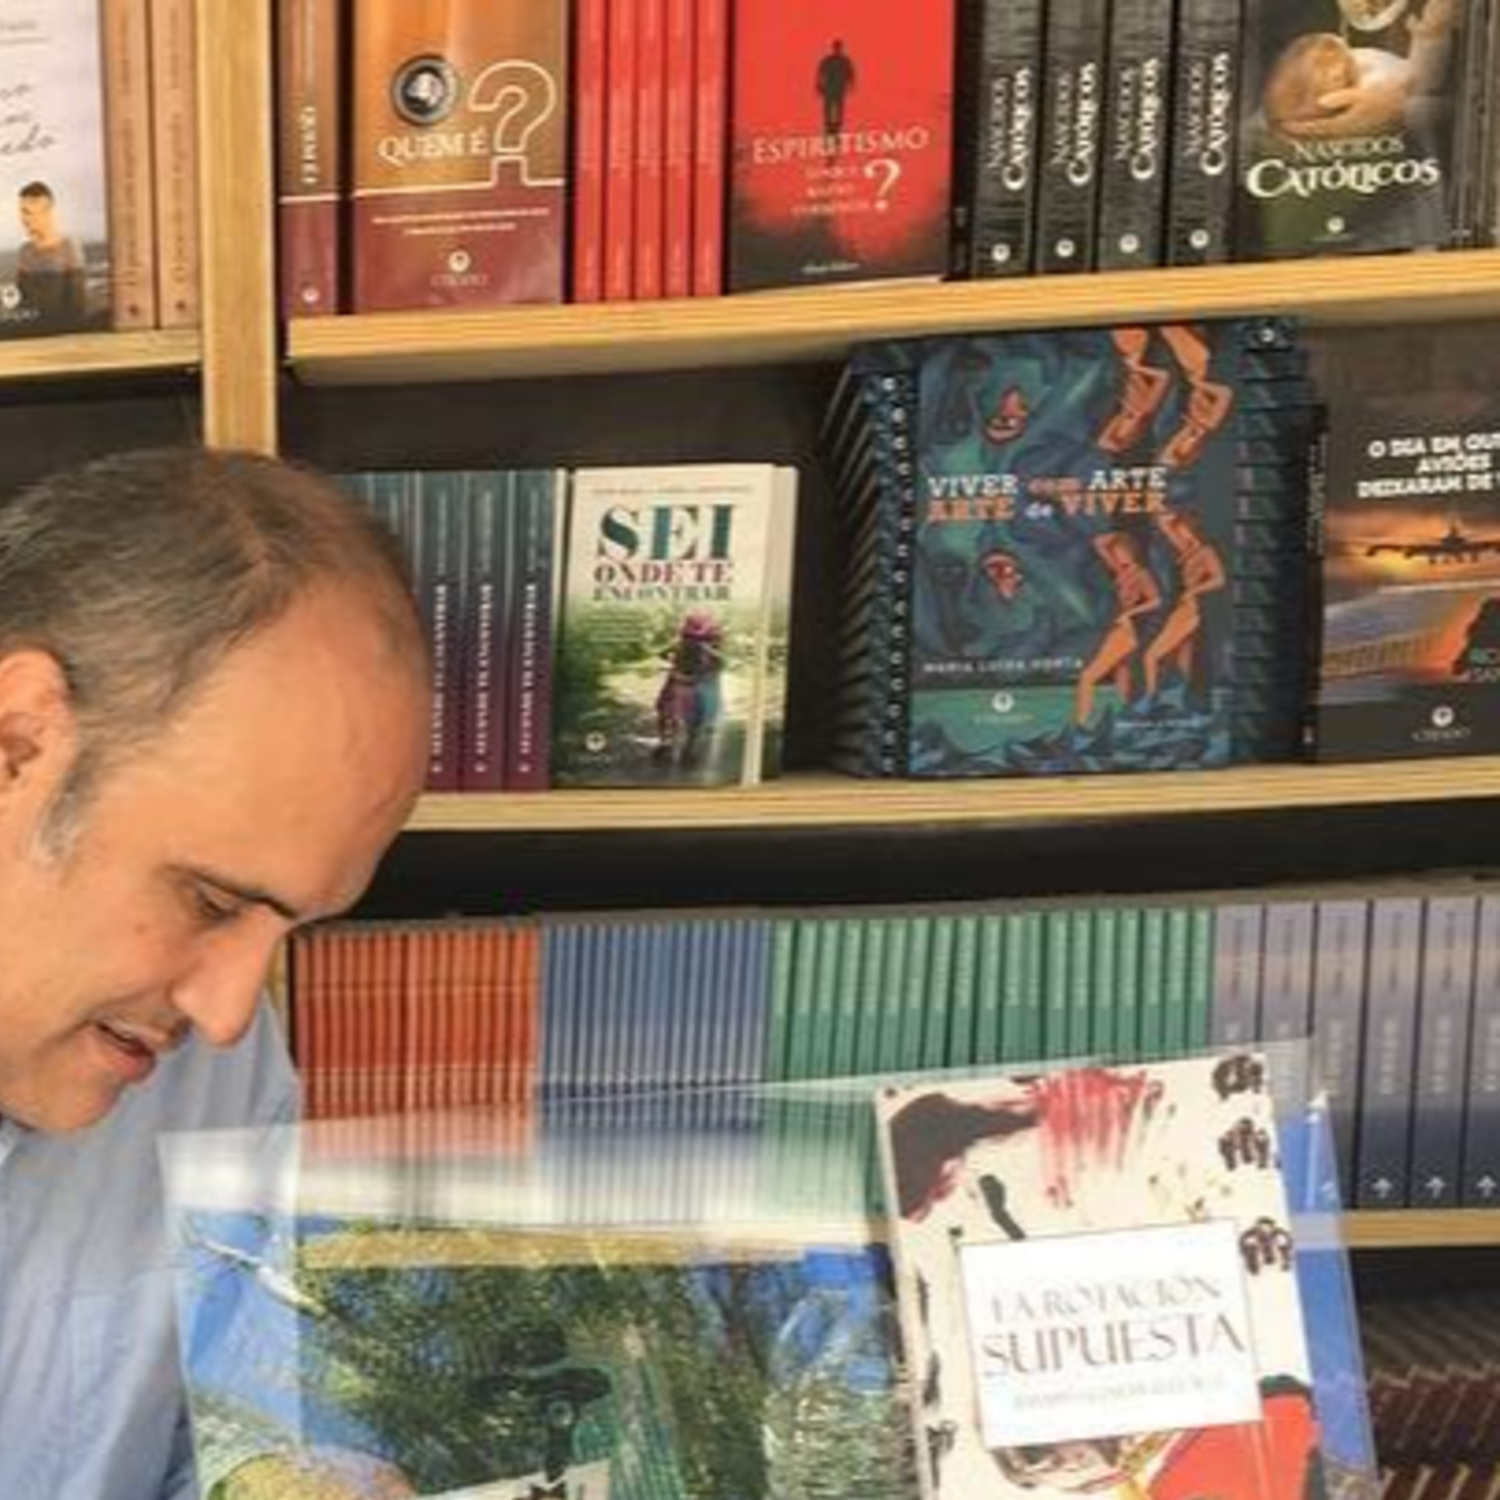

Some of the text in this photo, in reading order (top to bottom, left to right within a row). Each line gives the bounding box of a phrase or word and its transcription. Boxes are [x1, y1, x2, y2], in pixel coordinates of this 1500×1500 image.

[377, 134, 465, 167] QUEM
[752, 126, 930, 164] ESPIRITISMO
[1293, 136, 1405, 163] NASCIDOS
[1245, 158, 1442, 198] CATÓLICOS
[1368, 440, 1386, 458] O
[926, 474, 1018, 499] VIVER
[1088, 467, 1167, 492] ARTE
[927, 492, 1167, 522] ARTE de VIVER
[597, 503, 737, 561] SEI
[593, 561, 732, 583] ONDE TE
[593, 586, 731, 601] ENCONTRAR
[991, 1290, 1035, 1323] LA
[981, 1313, 1246, 1378] SUPUESTA
